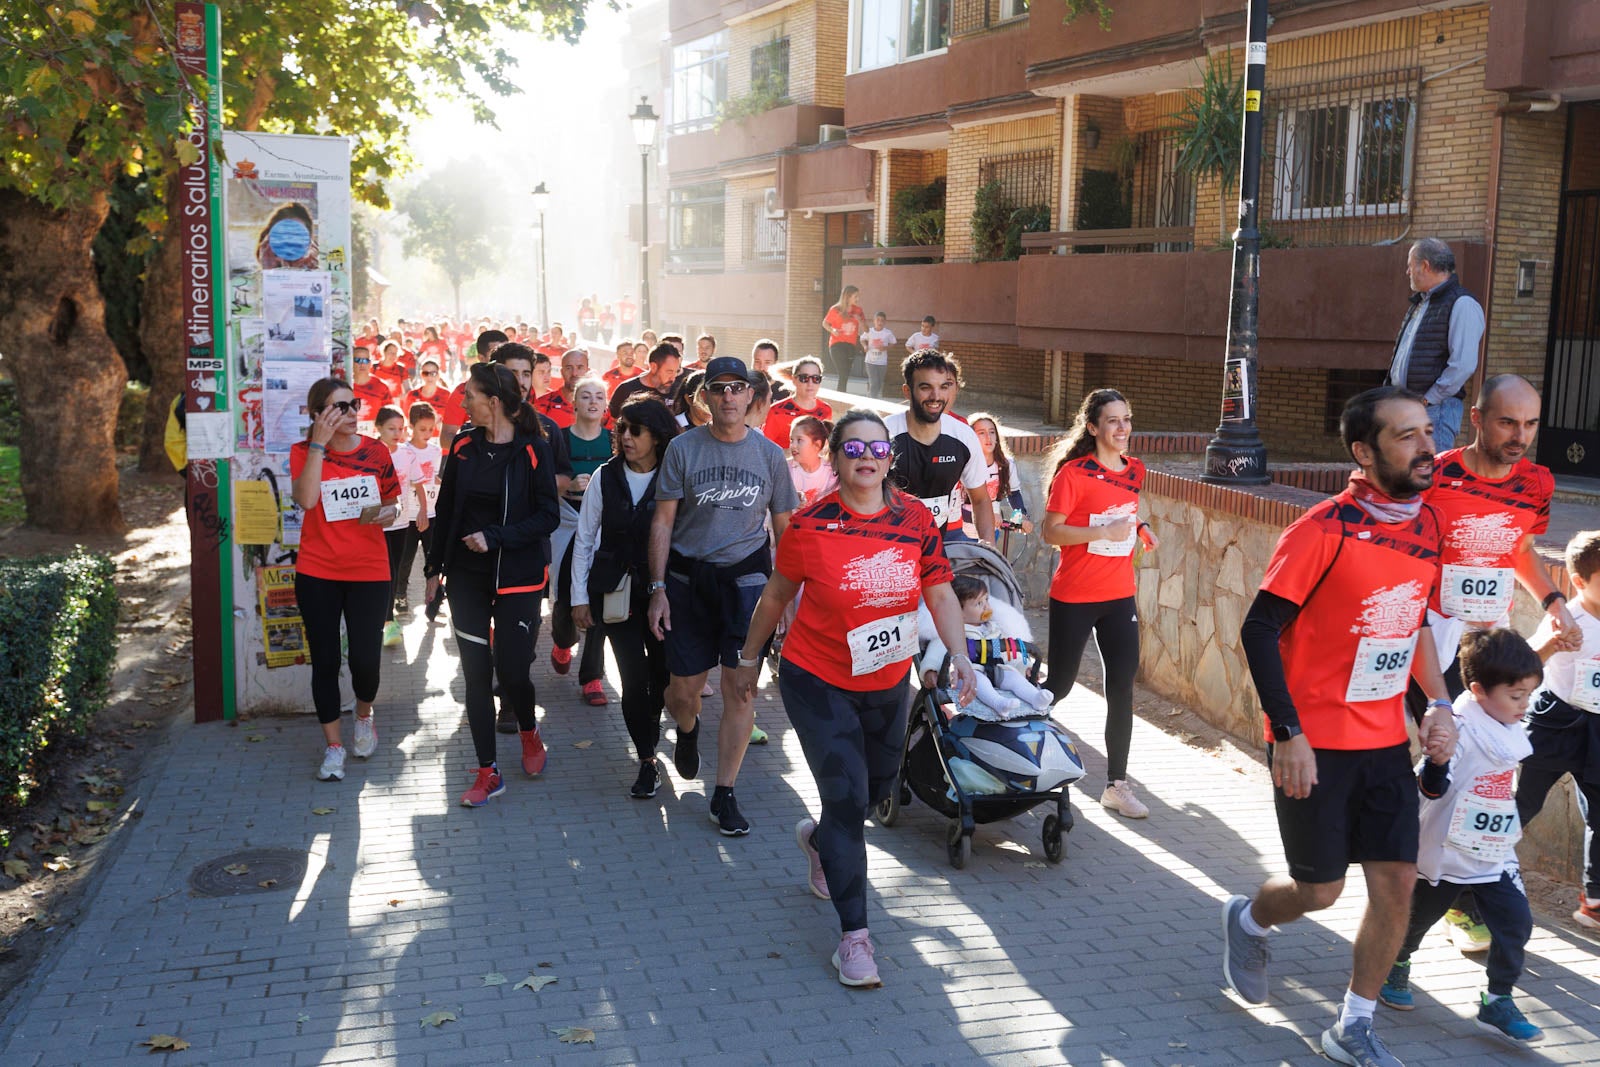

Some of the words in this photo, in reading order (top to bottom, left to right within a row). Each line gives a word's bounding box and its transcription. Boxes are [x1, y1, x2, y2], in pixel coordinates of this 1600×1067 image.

[189, 361, 222, 369] MPS
[939, 455, 956, 463] ELCA
[331, 485, 370, 501] 1402
[695, 482, 760, 507] Training
[1452, 528, 1517, 542] carrera
[847, 563, 914, 580] carrera
[1461, 578, 1498, 596] 602
[867, 626, 901, 653] 291
[1374, 650, 1410, 672] 985
[1473, 812, 1515, 833] 987
